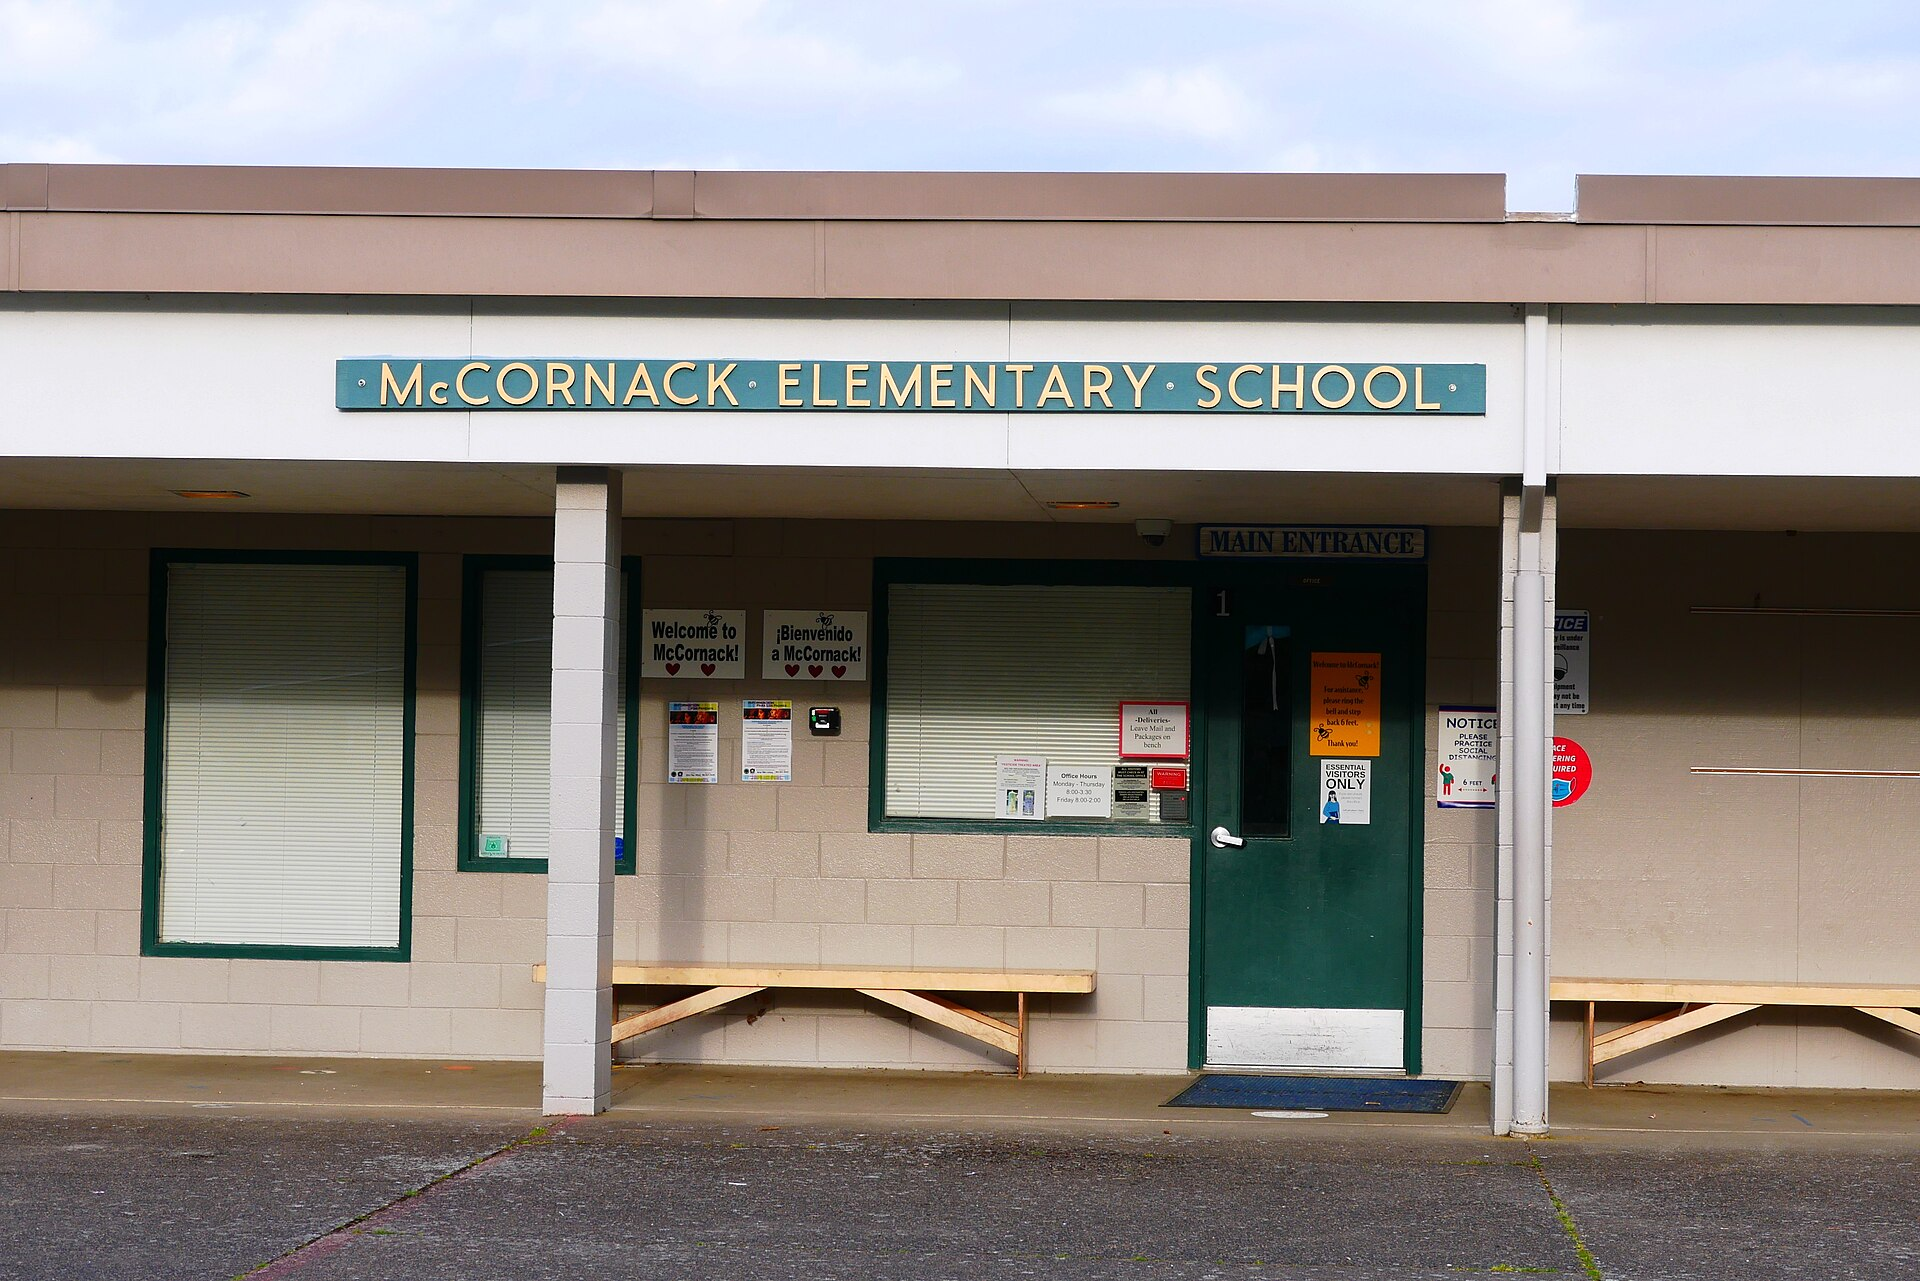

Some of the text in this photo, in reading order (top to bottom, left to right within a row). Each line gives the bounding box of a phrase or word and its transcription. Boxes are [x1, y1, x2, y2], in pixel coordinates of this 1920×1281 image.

[379, 361, 1442, 411] McCORNACK ELEMENTARY SCHOOL
[1209, 530, 1415, 554] MAIN ENTRANCE
[1216, 590, 1230, 617] 1
[651, 621, 737, 640] Welcome to
[1555, 618, 1585, 630] ICE
[776, 624, 853, 644] ¡Bienvenido
[653, 643, 739, 662] McCornack!
[771, 645, 862, 662] a McCornack!
[1323, 697, 1340, 705] please
[1326, 778, 1366, 790] ONLY
